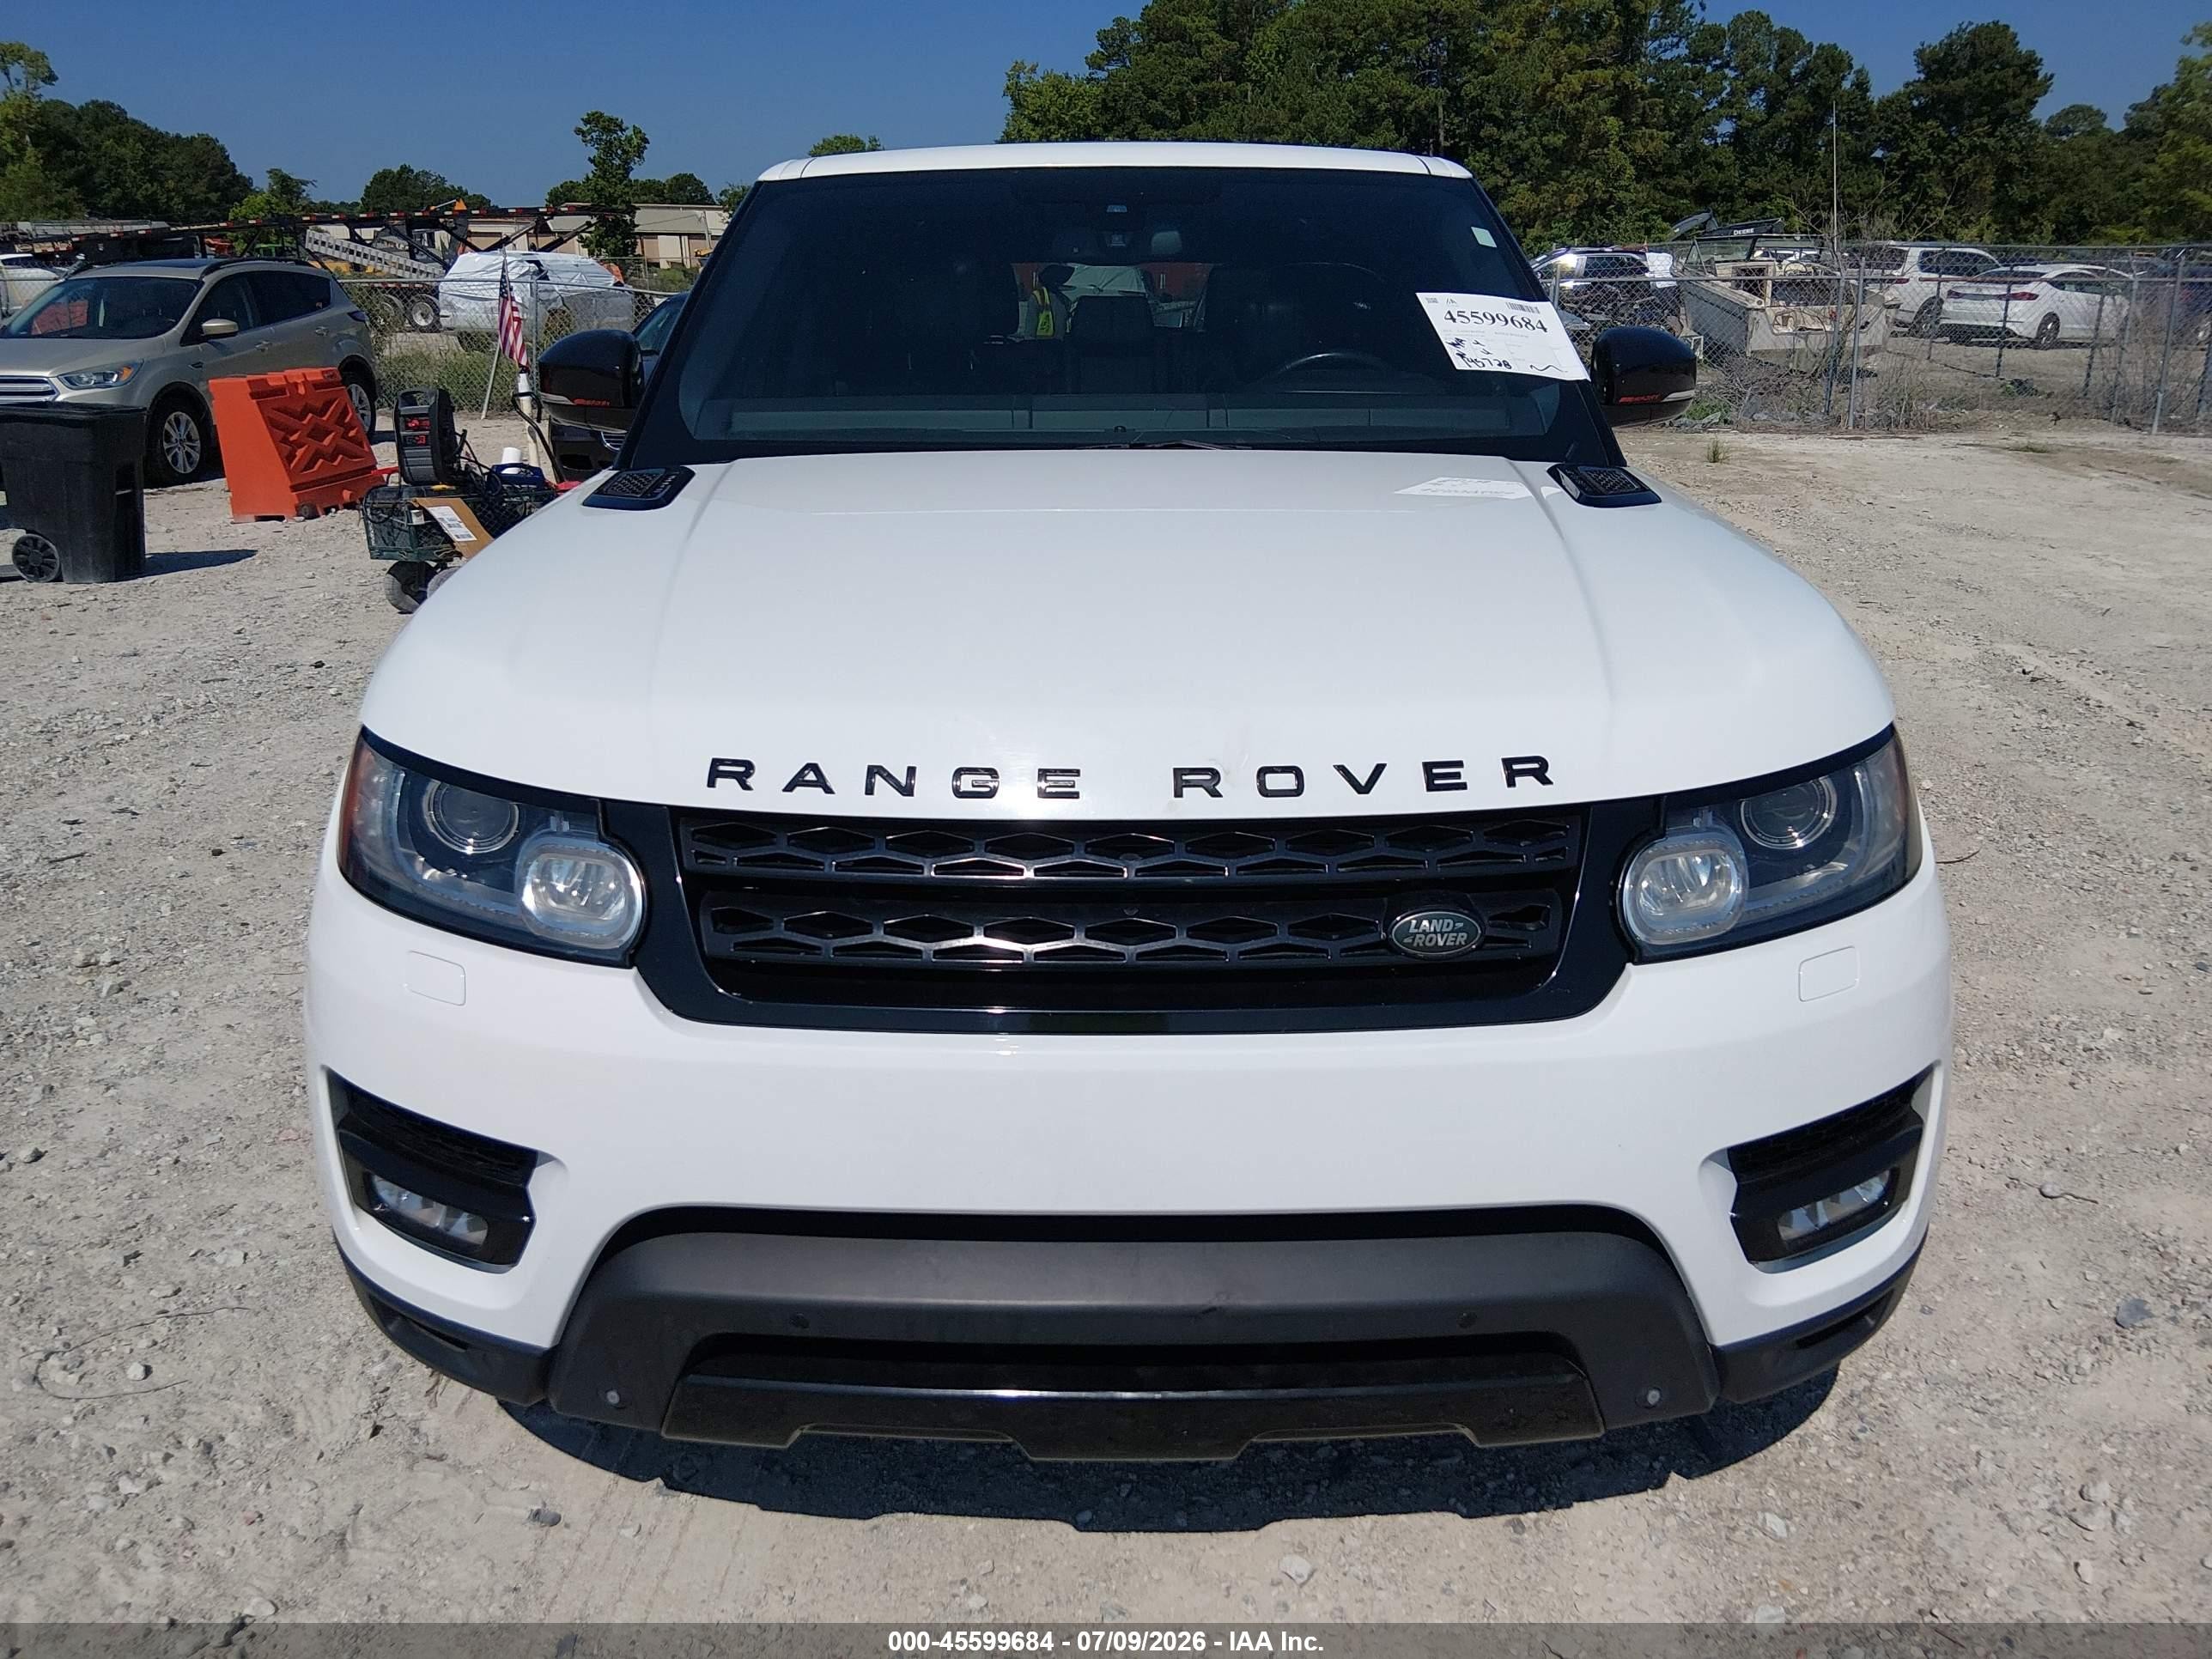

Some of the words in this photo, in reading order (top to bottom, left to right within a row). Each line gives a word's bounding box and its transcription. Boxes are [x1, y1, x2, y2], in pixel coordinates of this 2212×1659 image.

[1444, 310, 1547, 333] 45599684
[707, 757, 1081, 799] RANGE
[1172, 755, 1554, 799] ROVER
